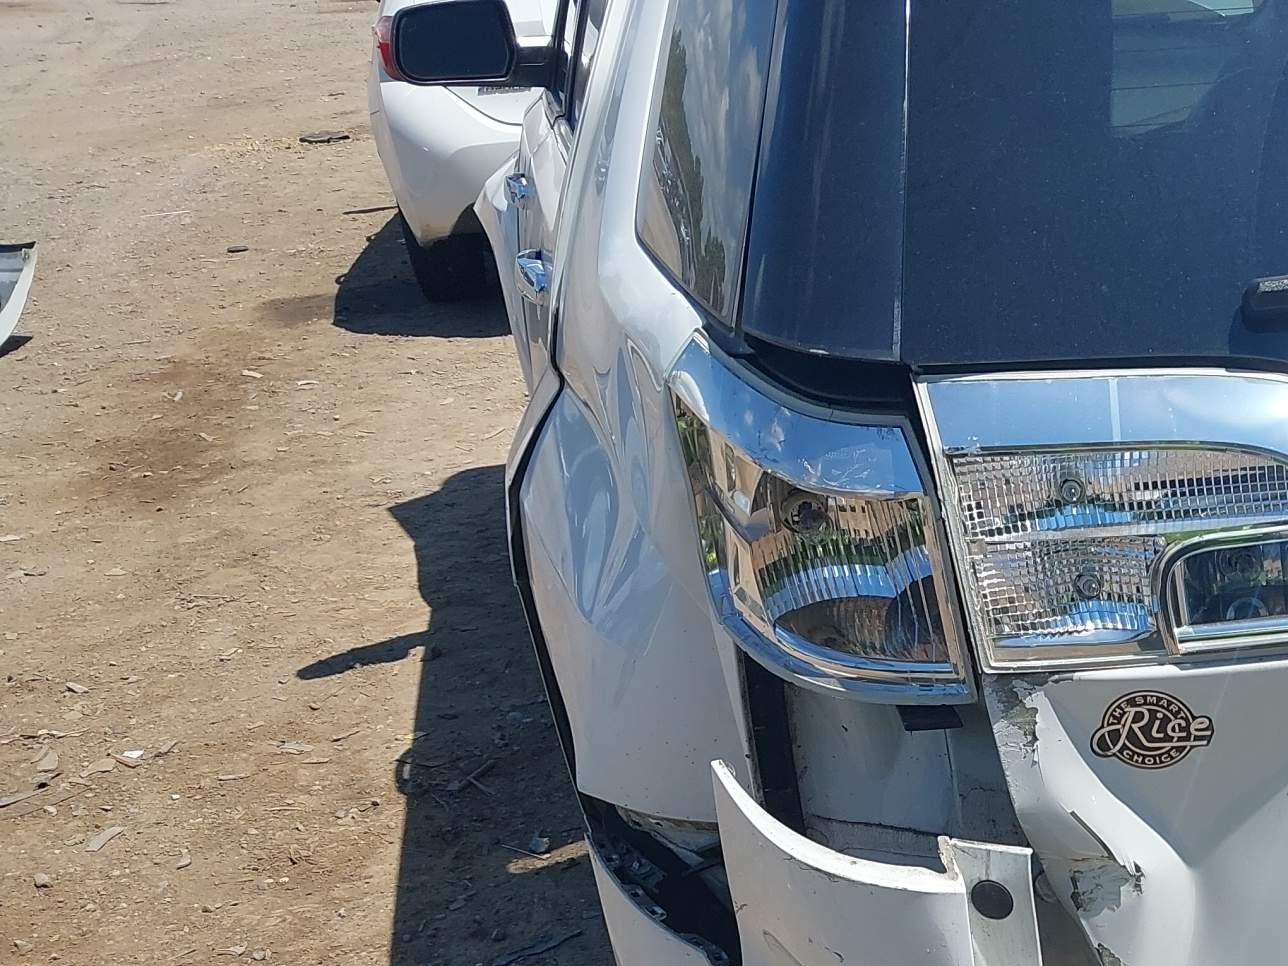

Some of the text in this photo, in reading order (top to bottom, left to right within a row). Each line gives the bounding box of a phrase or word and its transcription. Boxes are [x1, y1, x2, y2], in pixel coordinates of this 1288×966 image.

[1109, 696, 1186, 725] THE SMART
[1092, 706, 1212, 756] Rice
[1123, 749, 1180, 765] CHOICE
